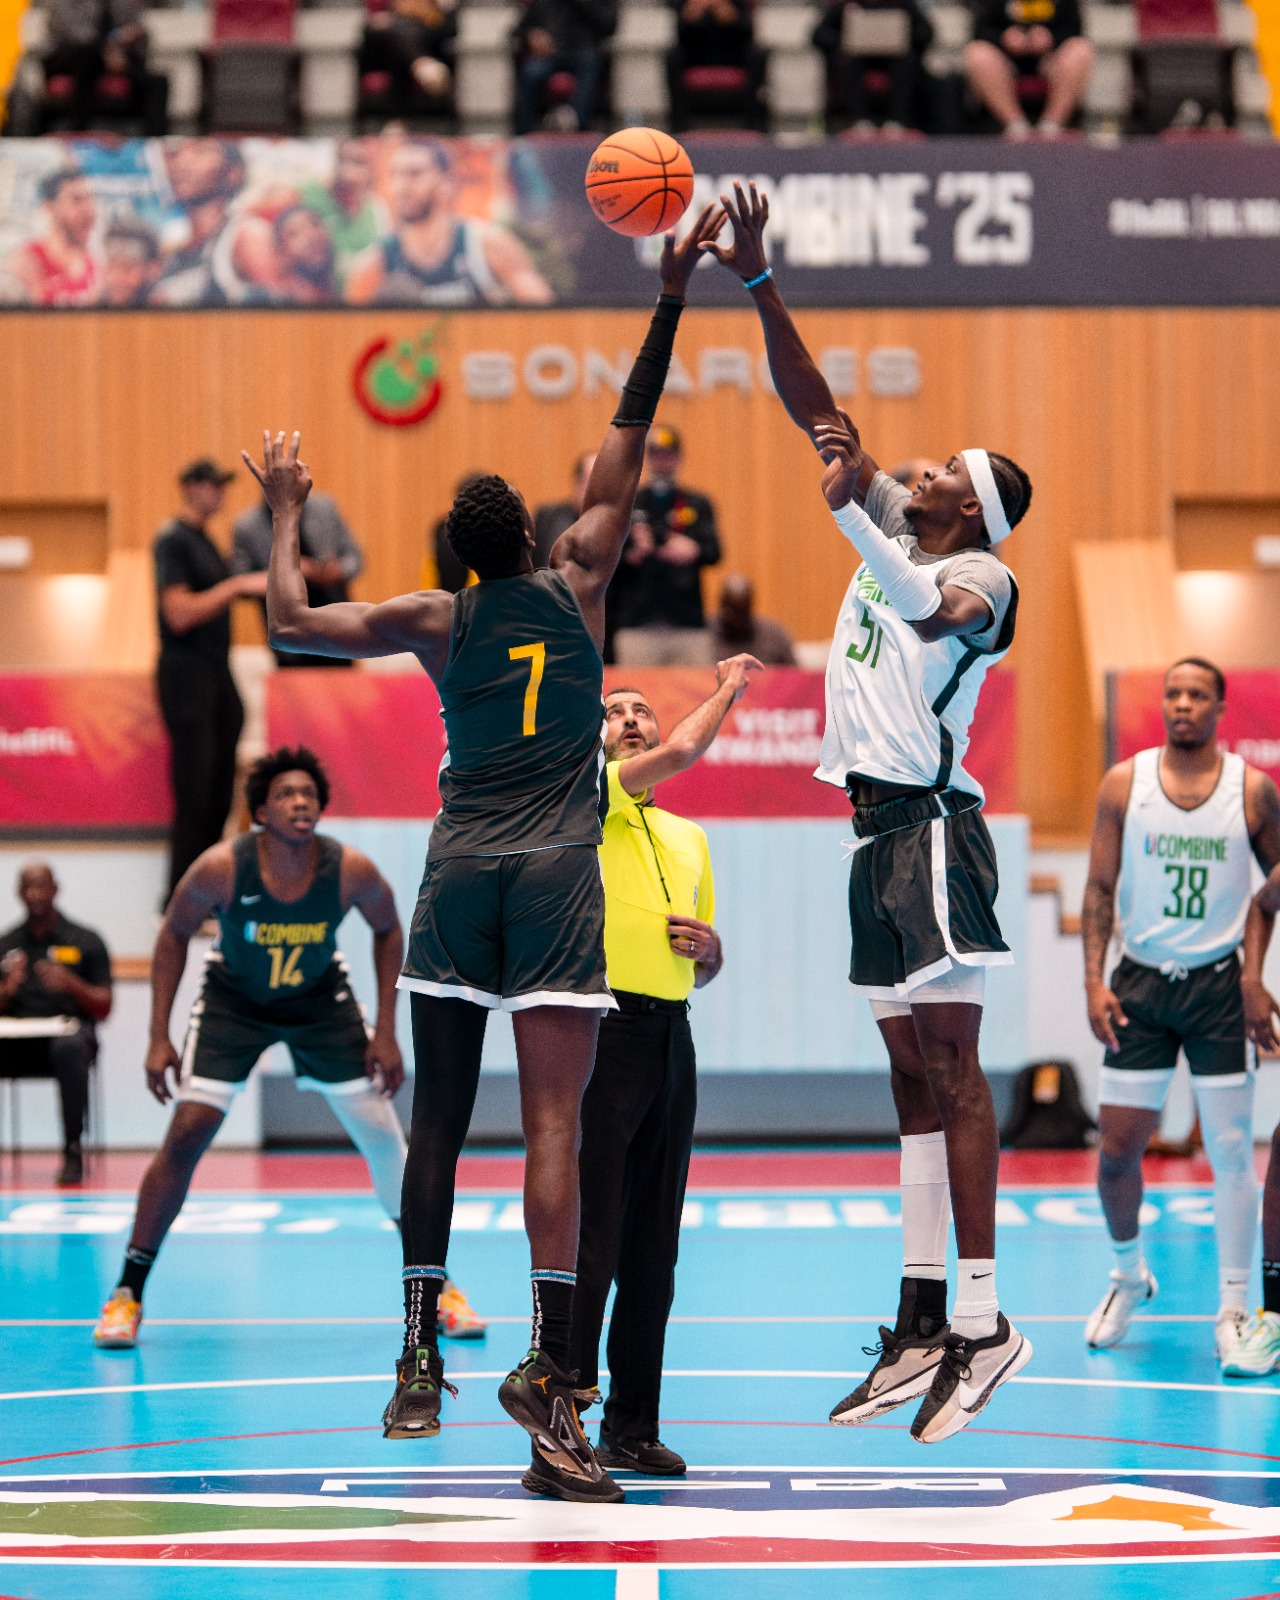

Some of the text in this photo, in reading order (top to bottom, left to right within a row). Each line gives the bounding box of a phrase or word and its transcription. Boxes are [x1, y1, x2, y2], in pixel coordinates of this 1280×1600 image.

[936, 171, 1033, 266] '25
[508, 642, 546, 736] 7
[1157, 833, 1229, 861] COMBINE
[1163, 864, 1209, 920] 38
[256, 922, 329, 947] COMBINE
[266, 946, 305, 990] 14
